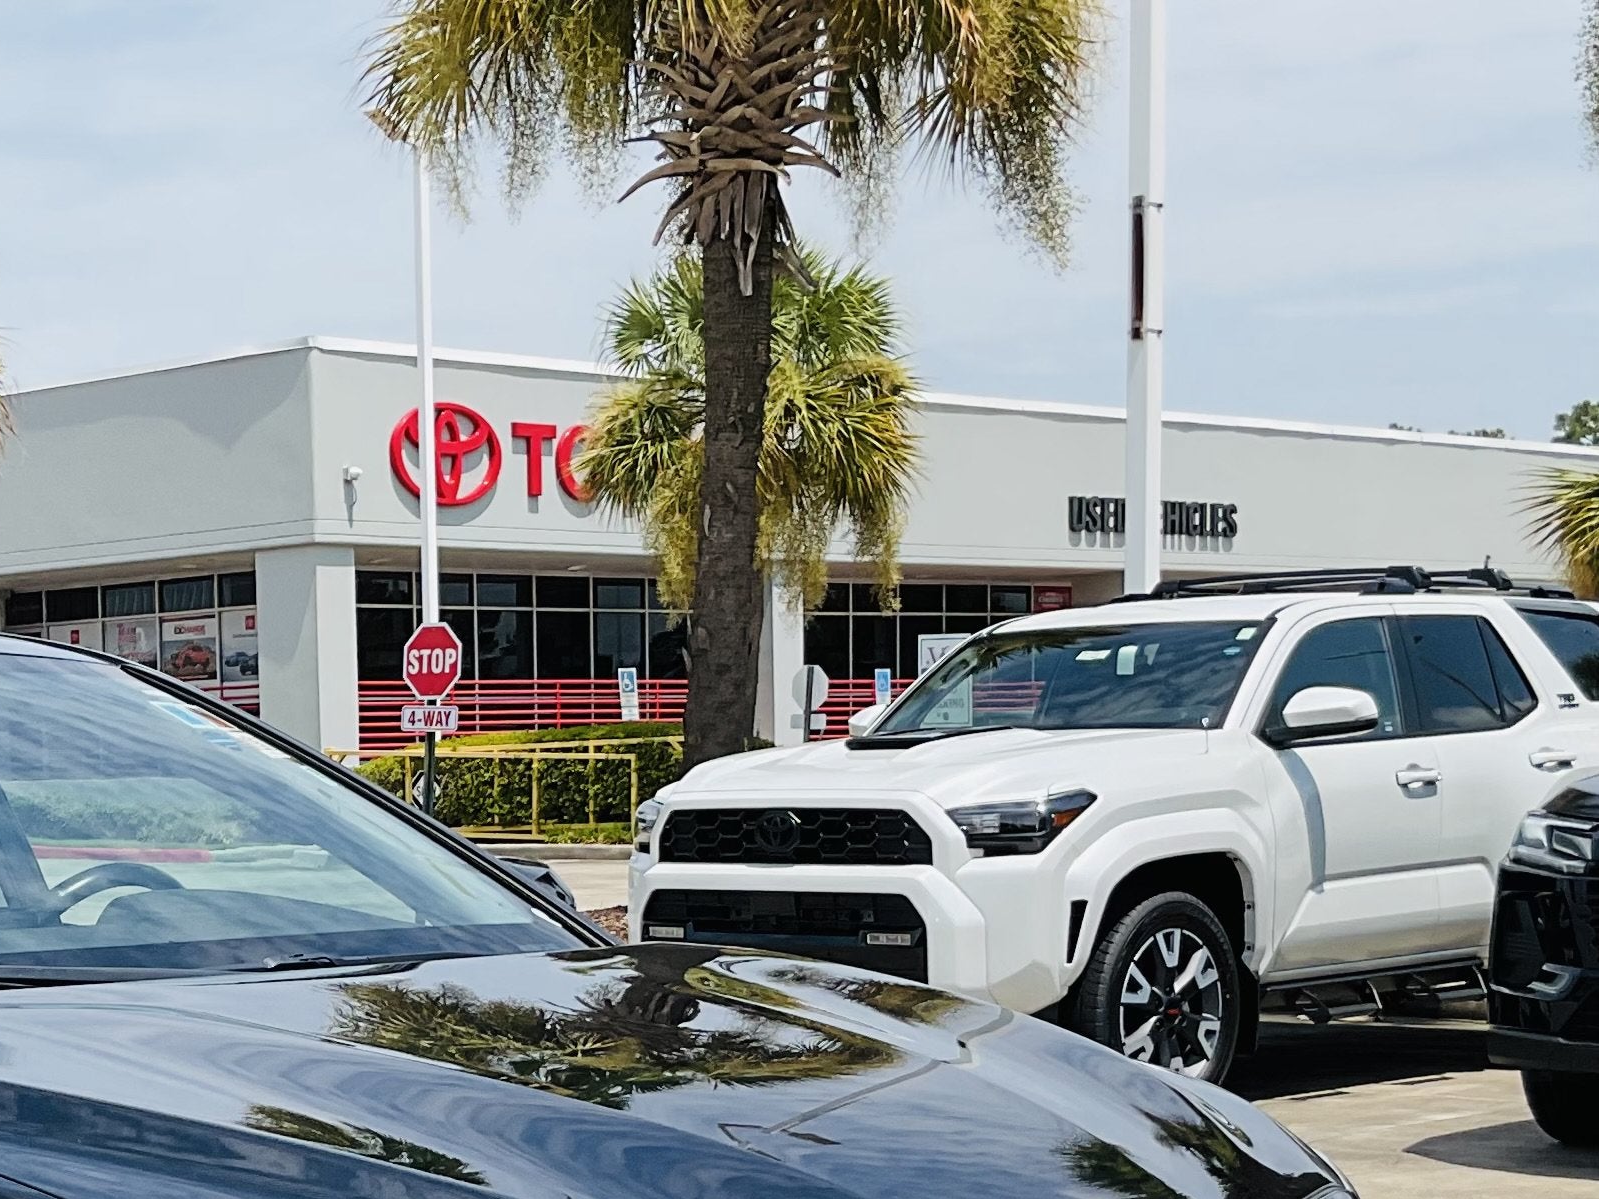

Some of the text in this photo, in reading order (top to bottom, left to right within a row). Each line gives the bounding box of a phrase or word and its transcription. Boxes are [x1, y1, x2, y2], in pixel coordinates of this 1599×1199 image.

[1158, 500, 1238, 538] HICLES
[407, 647, 457, 675] STOP
[407, 710, 452, 727] 4-WAY
